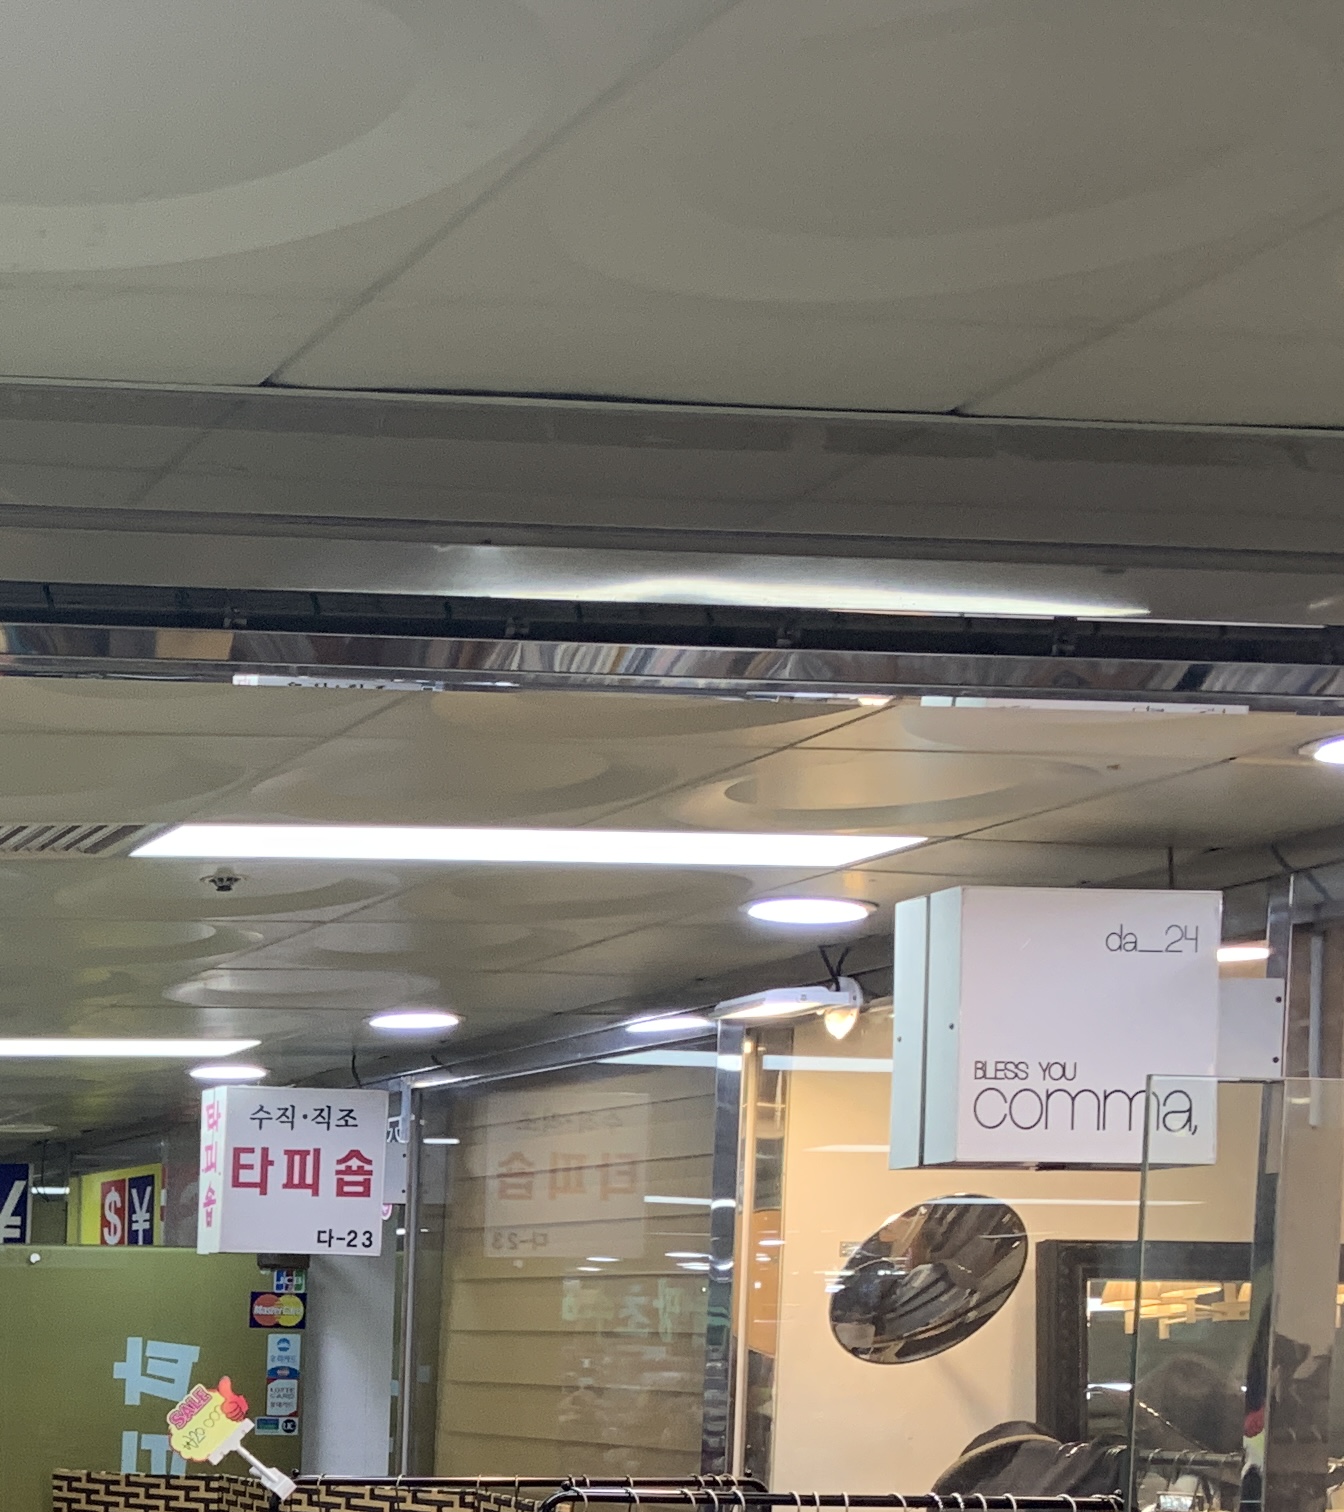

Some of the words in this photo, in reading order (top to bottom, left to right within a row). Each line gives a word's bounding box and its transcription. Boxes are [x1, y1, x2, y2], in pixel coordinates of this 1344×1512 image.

[974, 1060, 1029, 1081] BLESS
[1038, 1061, 1077, 1081] YOU
[249, 1104, 358, 1131] 수직·직조
[231, 1146, 374, 1198] 타피숍
[316, 1228, 374, 1248] 다-23
[169, 1385, 212, 1430] SALE
